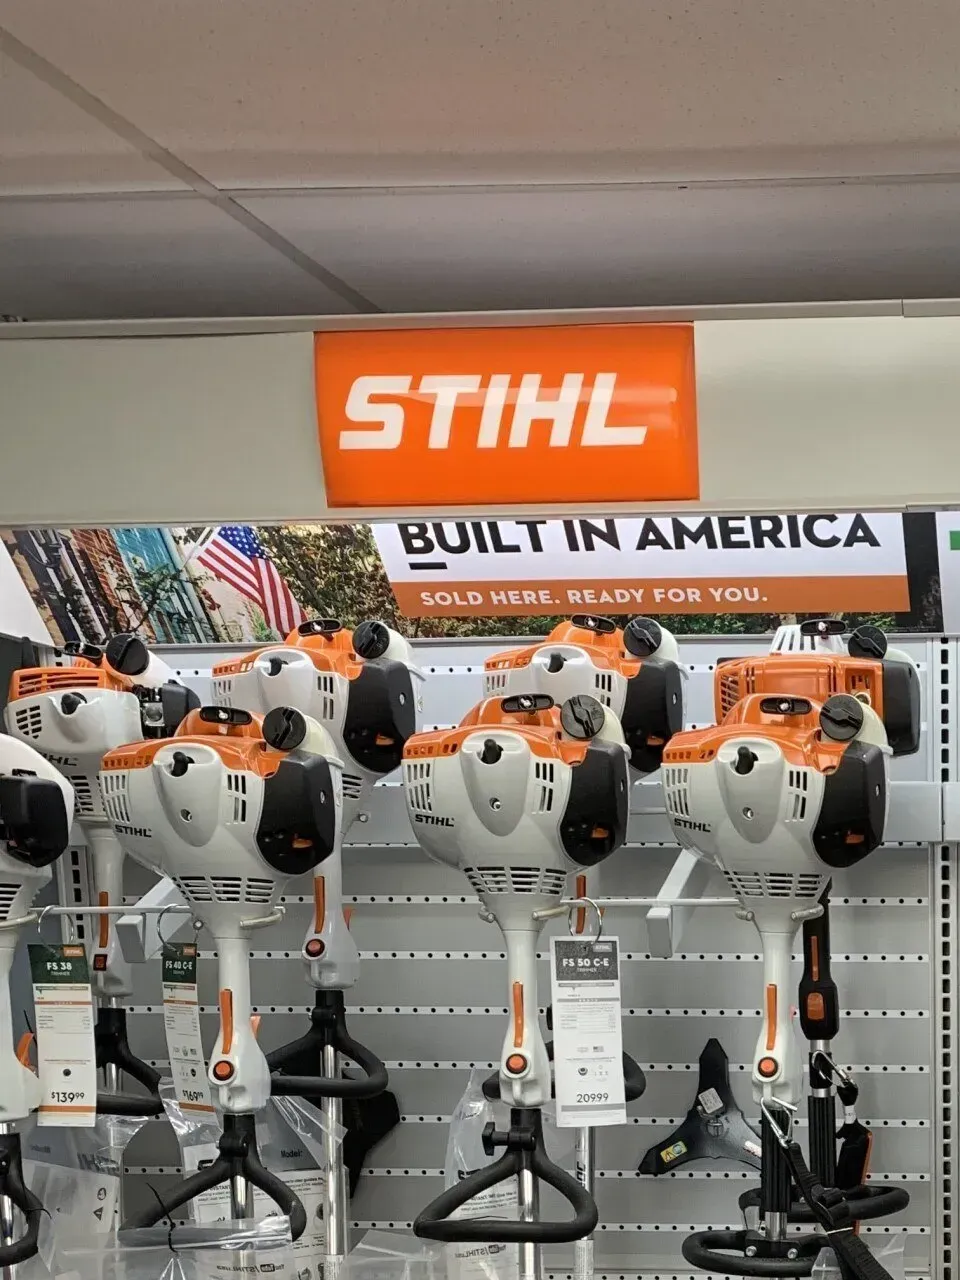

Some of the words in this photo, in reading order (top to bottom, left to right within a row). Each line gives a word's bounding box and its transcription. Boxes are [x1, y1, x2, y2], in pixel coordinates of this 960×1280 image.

[339, 372, 648, 450] STIHL
[399, 521, 547, 555] BUILT
[562, 519, 621, 553] IN
[635, 513, 881, 552] AMERICA
[421, 590, 484, 607] SOLD
[490, 589, 560, 606] HERE.
[568, 588, 647, 605] READY
[653, 588, 702, 603] FOR
[709, 586, 768, 603] YOU.
[415, 813, 454, 827] STIHL
[673, 817, 711, 833] STIHL
[115, 824, 152, 838] STIHL
[46, 962, 58, 971] FS
[60, 962, 73, 971] 38
[166, 961, 173, 969] FS
[174, 961, 182, 969] 40
[183, 962, 193, 970] C-E
[562, 958, 575, 967] FS
[578, 958, 591, 967] 50
[594, 958, 610, 966] C-E
[576, 1162, 587, 1188] 0C
